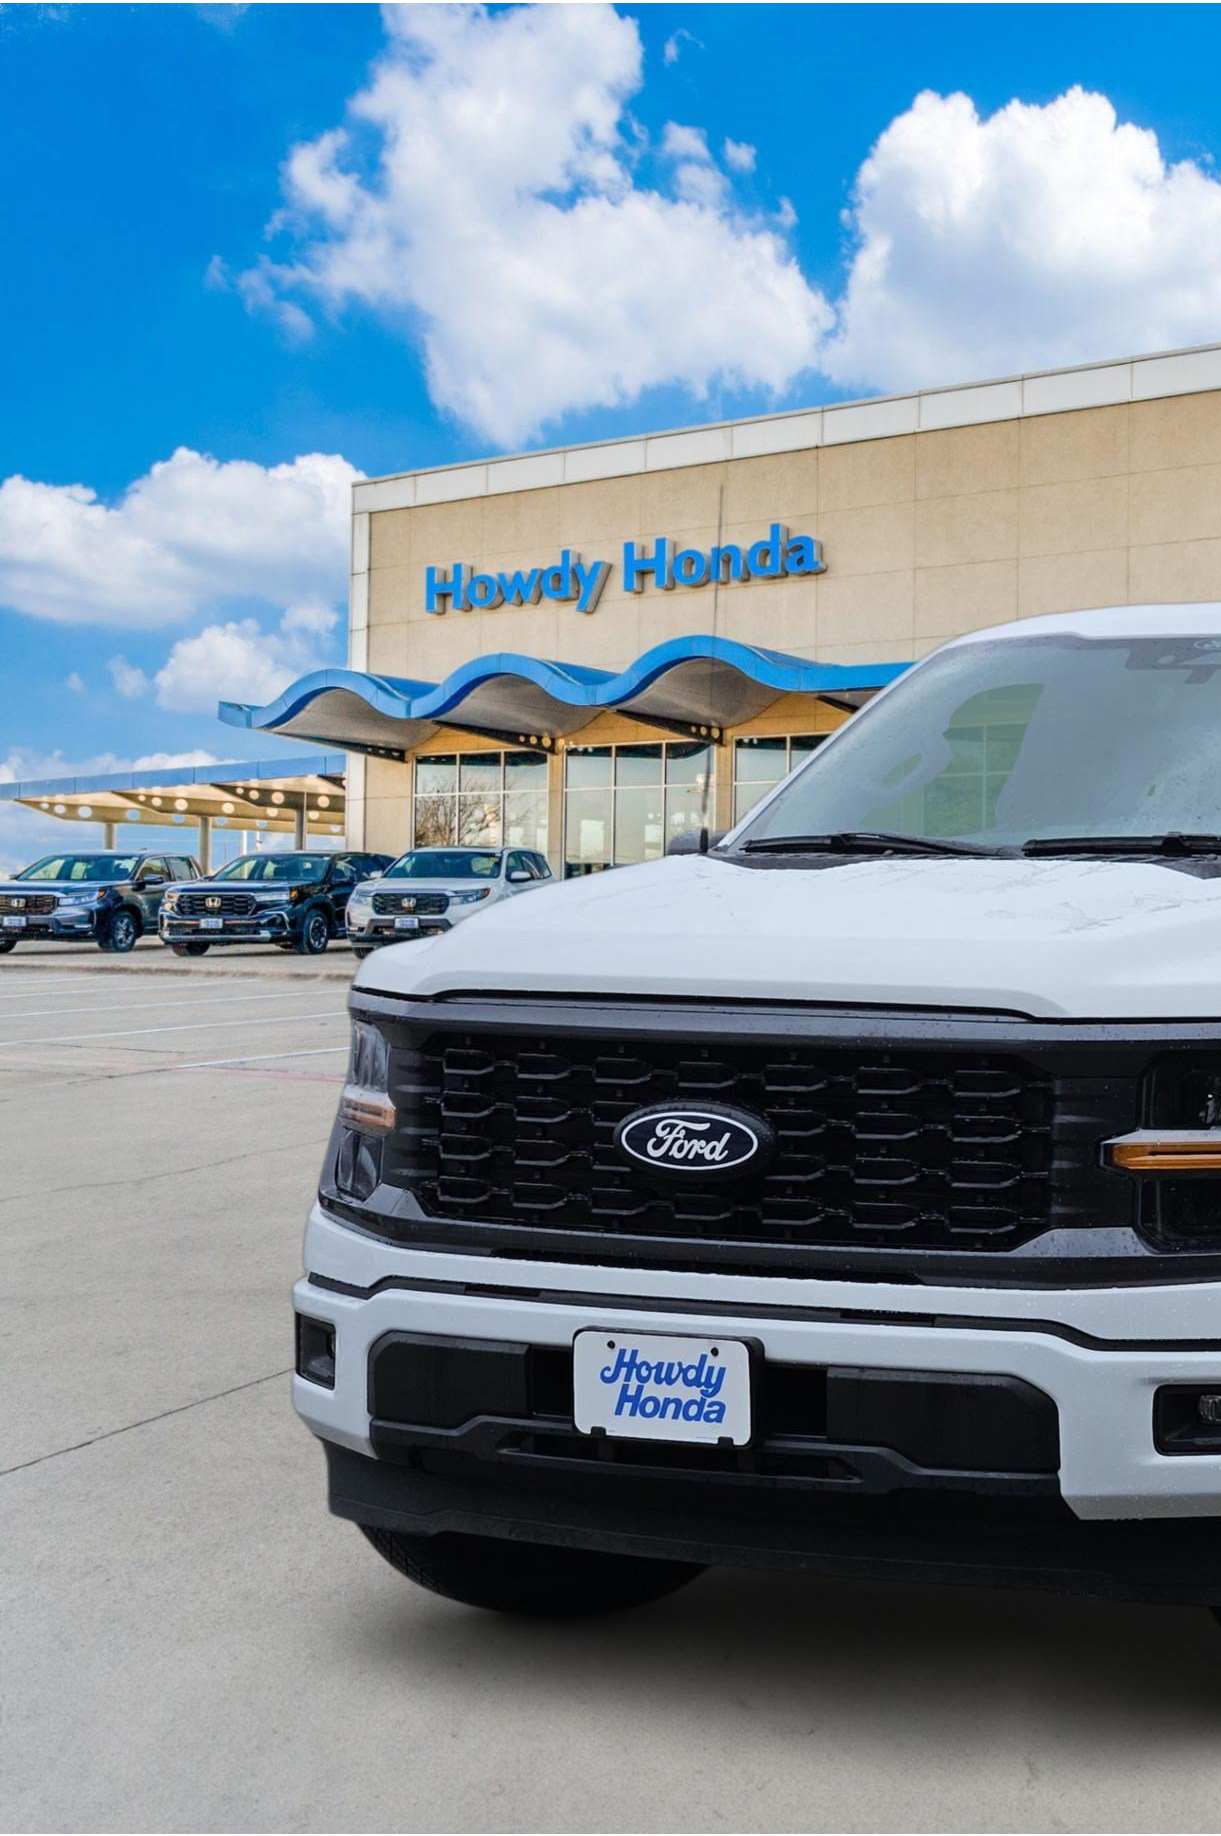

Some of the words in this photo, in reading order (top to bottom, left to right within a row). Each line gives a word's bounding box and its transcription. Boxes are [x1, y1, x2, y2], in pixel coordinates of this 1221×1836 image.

[425, 549, 611, 614] Howdy
[623, 523, 825, 593] Honda
[647, 1119, 731, 1161] Ford
[600, 1348, 727, 1398] Howdy
[614, 1383, 726, 1424] Honda
